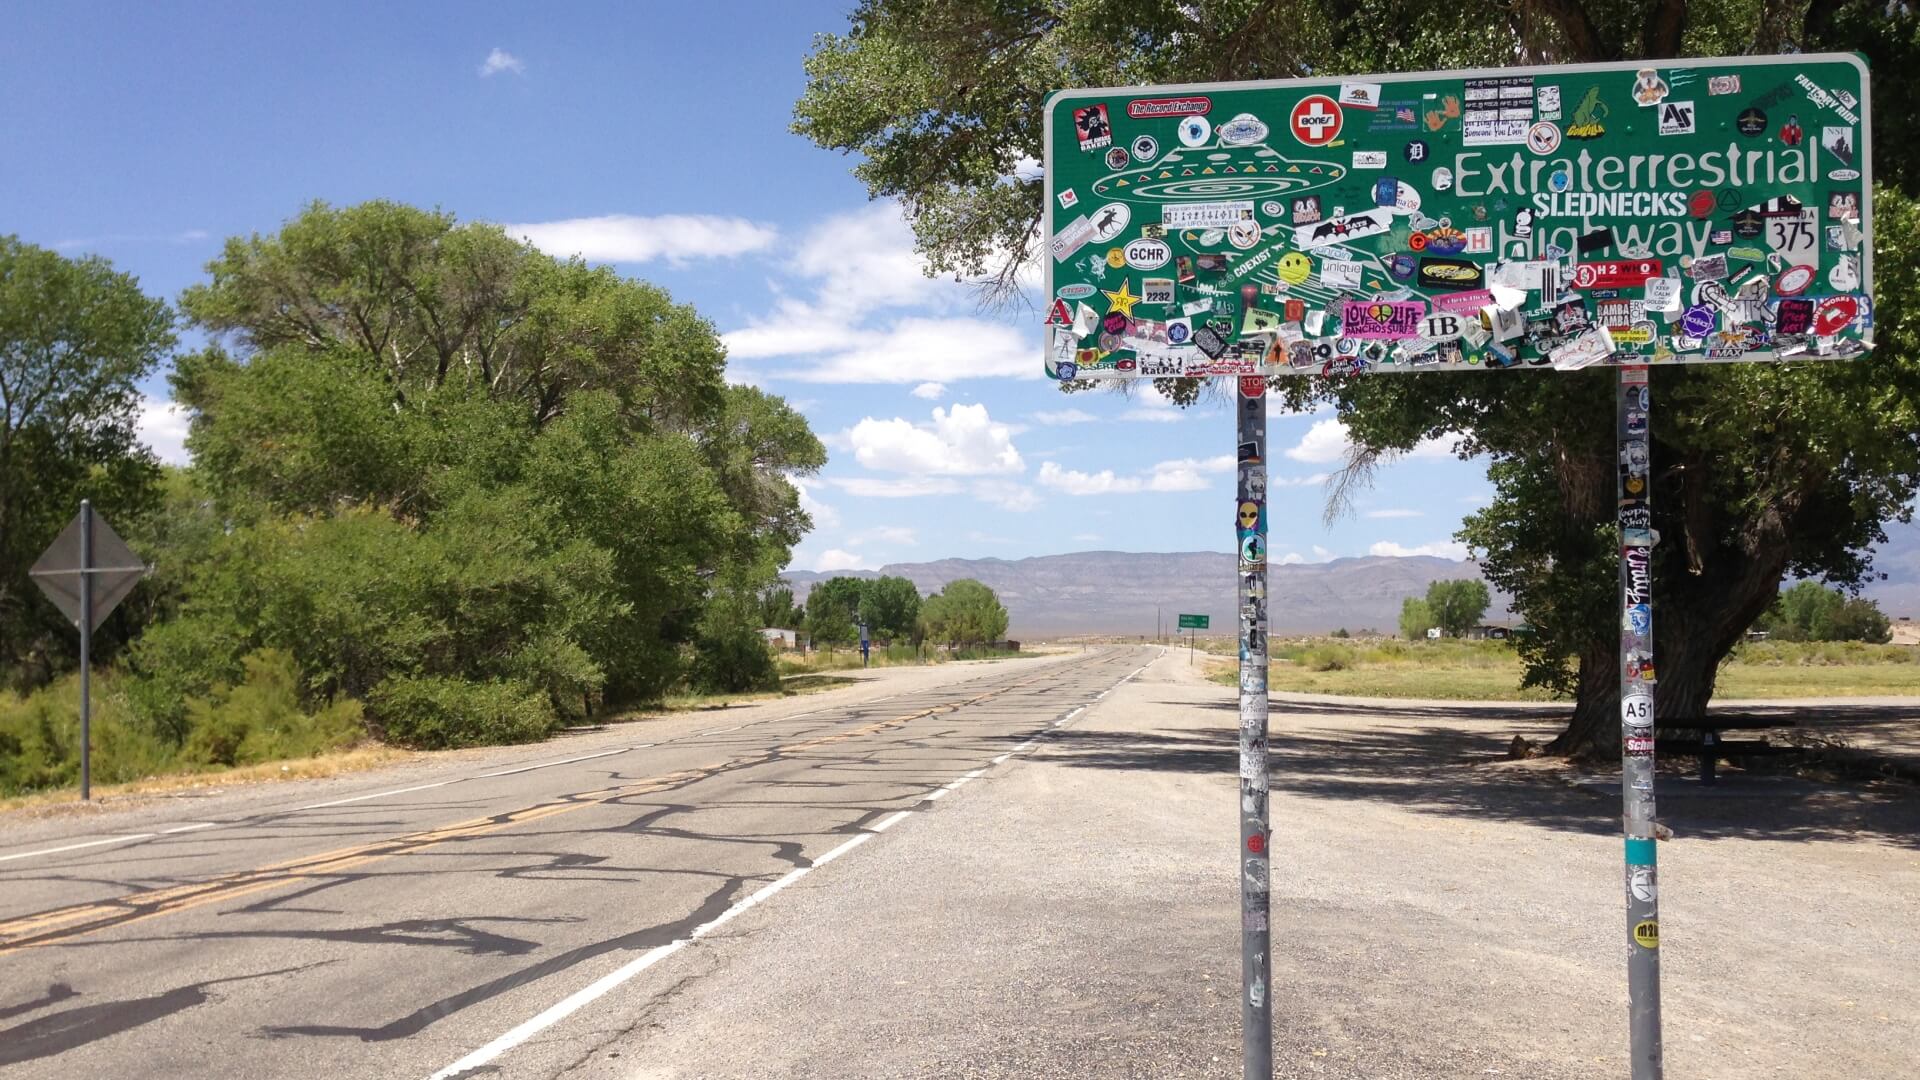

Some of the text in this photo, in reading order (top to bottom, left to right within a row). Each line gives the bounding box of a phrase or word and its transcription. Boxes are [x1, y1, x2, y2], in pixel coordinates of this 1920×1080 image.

[1131, 100, 1208, 115] The Record Exchange
[1834, 102, 1860, 126] RIDE
[1080, 139, 1112, 151] BAKERY
[1456, 135, 1818, 198] Extraterrestrial
[1773, 221, 1816, 252] 375
[1129, 247, 1164, 262] GCHR
[1233, 247, 1272, 278] COEXIST
[1322, 262, 1361, 277] unique
[1597, 263, 1657, 275] H 2 WHOA
[1146, 291, 1171, 303] 2232
[1822, 295, 1850, 308] WORKS
[1045, 297, 1075, 326] A
[1345, 304, 1422, 327] LOVE LIFE
[1597, 304, 1630, 316] RAMBA
[1427, 316, 1459, 337] IB
[1597, 315, 1630, 327] ZAMBA
[1716, 349, 1743, 358] MAX
[1141, 366, 1160, 376] Rat
[1162, 366, 1183, 376] Pac
[1241, 377, 1266, 388] STOP
[1626, 702, 1652, 718] A51
